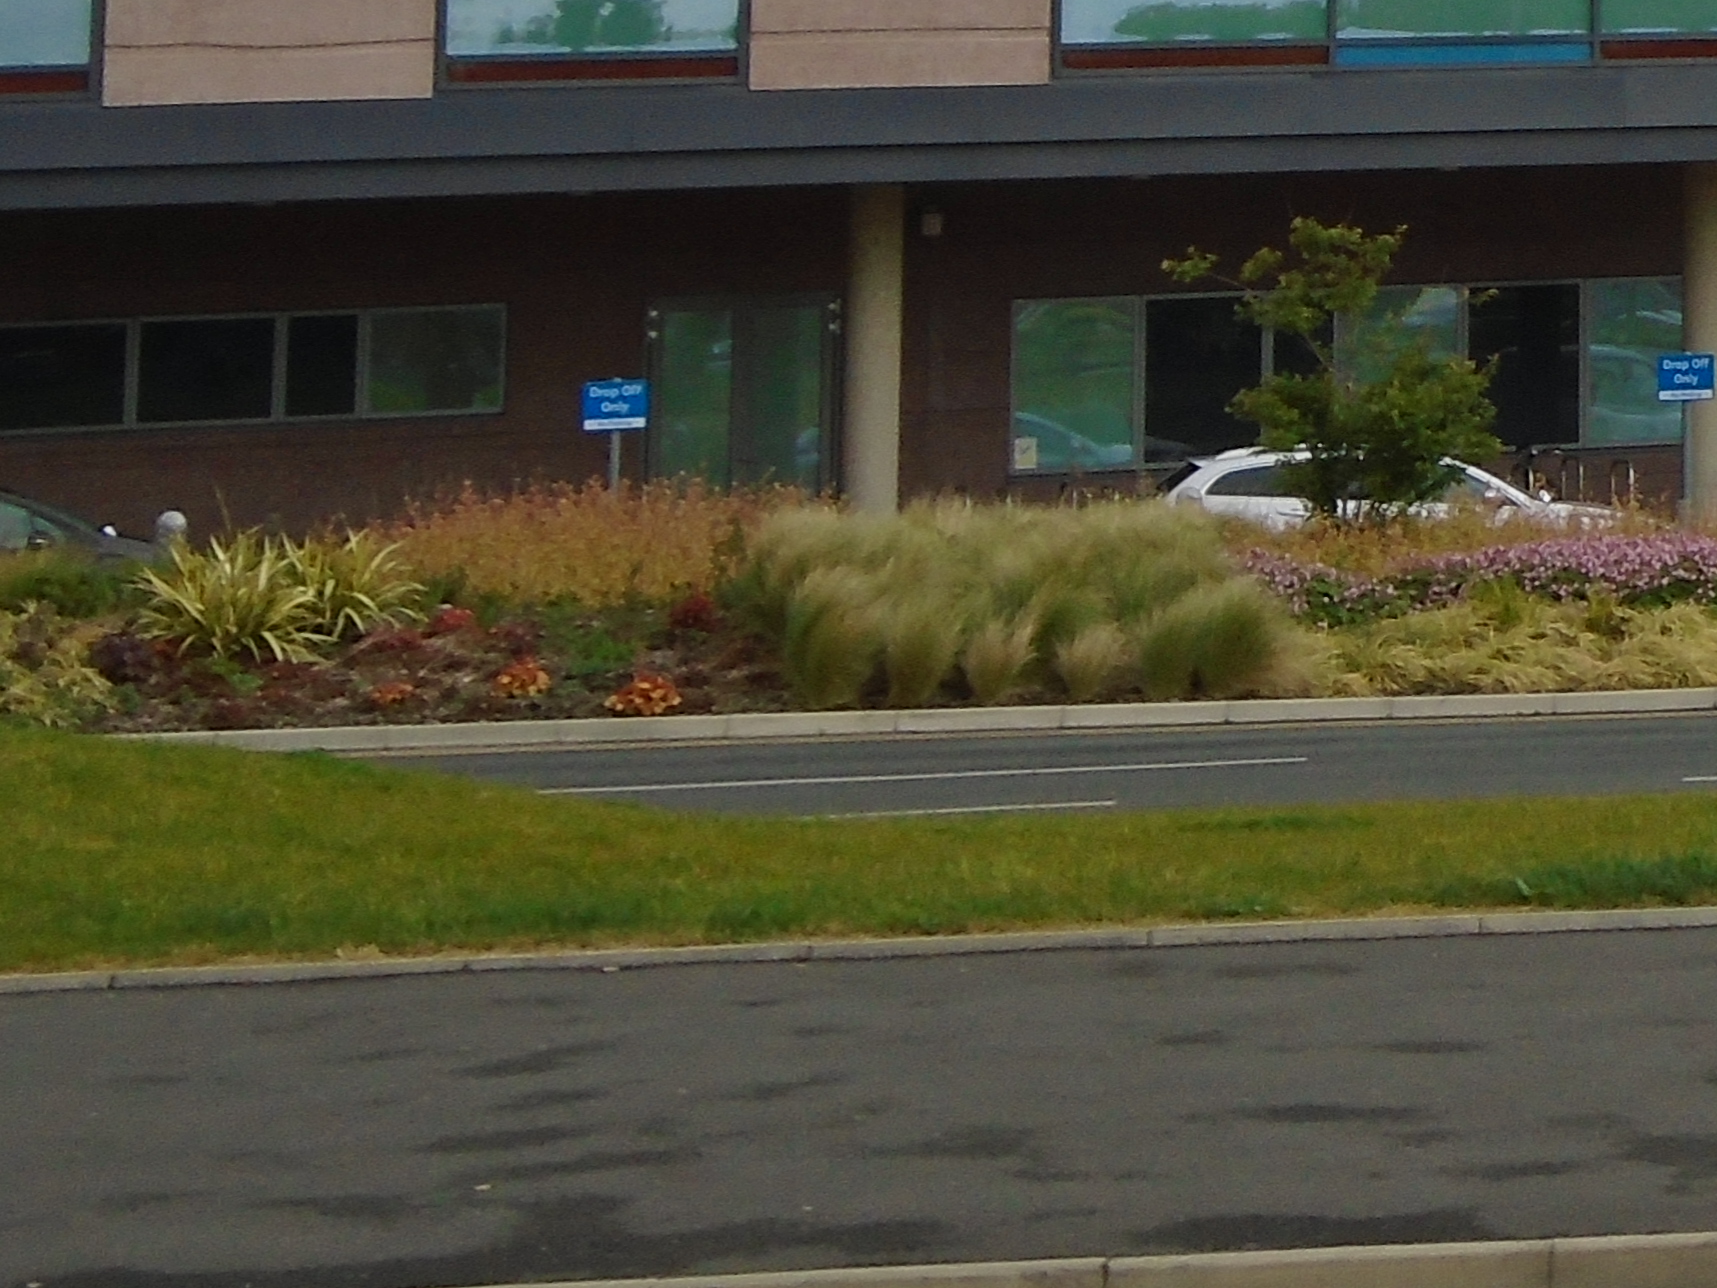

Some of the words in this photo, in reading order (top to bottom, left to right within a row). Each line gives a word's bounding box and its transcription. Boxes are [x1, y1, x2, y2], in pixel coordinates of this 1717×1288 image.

[1663, 359, 1689, 371] Drop
[1691, 358, 1709, 369] Off
[1674, 373, 1698, 386] Only
[589, 386, 619, 398] Drop
[601, 401, 630, 415] Only
